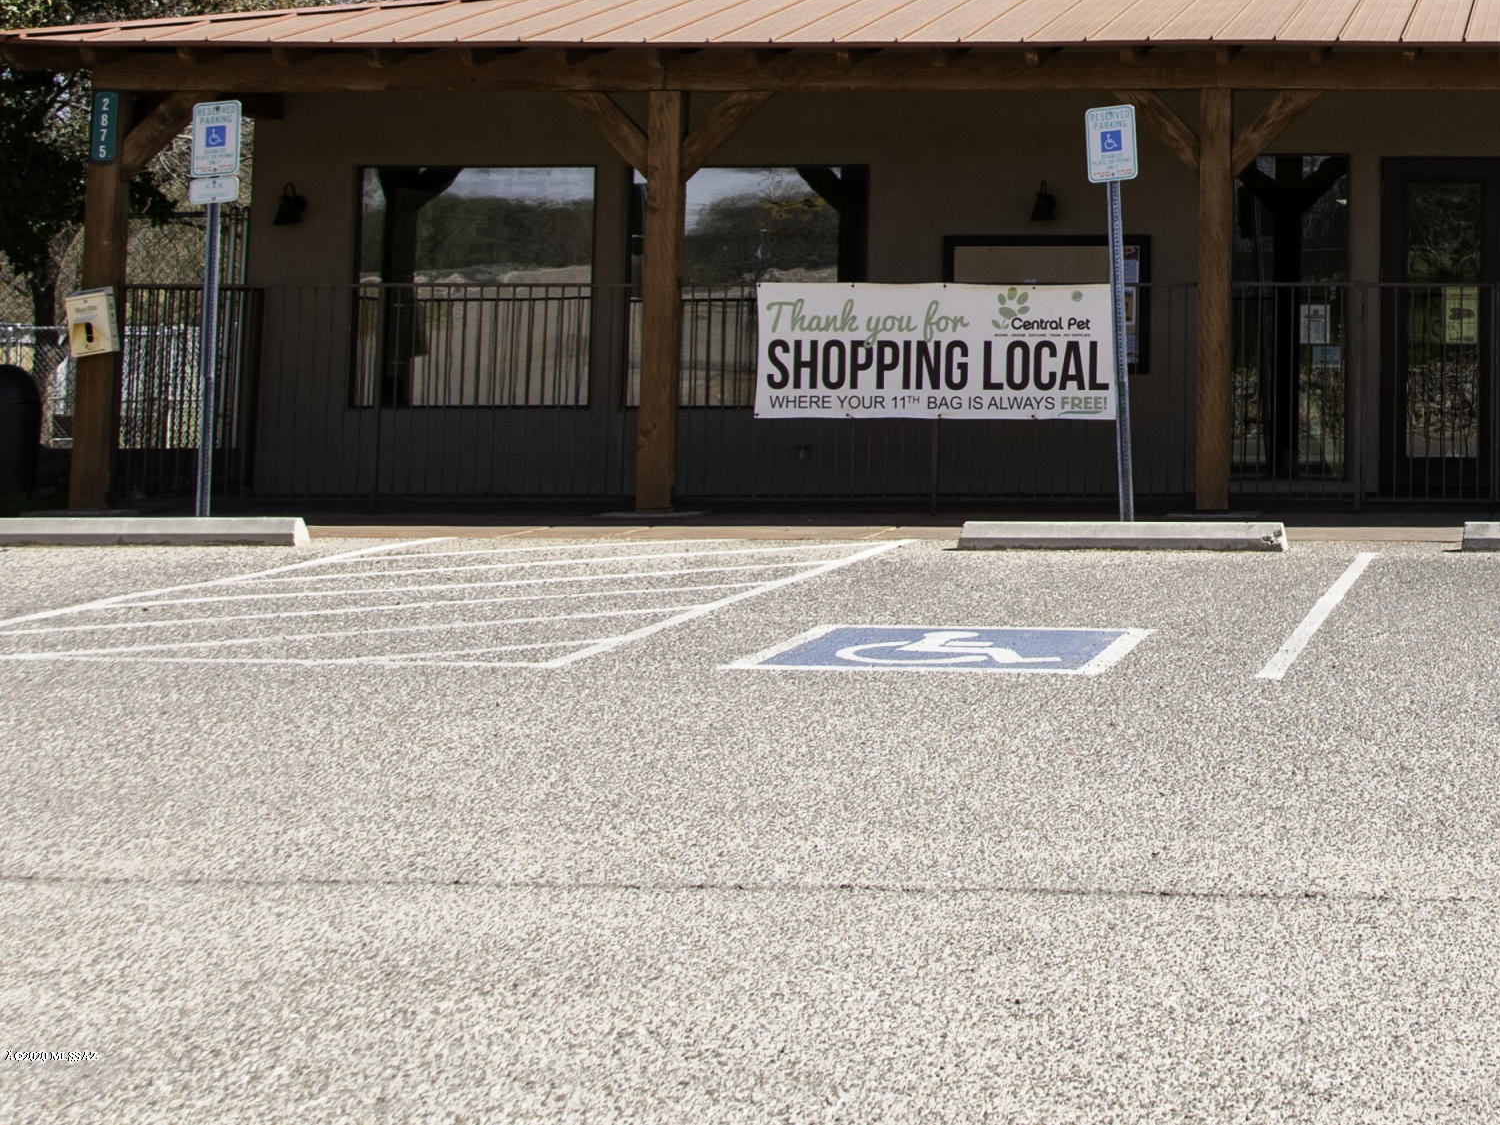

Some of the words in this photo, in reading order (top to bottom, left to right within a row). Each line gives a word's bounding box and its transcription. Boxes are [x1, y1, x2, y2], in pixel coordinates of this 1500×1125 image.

[98, 97, 110, 158] 2875
[199, 115, 233, 125] PARKING
[1094, 119, 1128, 130] PARKING
[766, 298, 859, 333] Thank
[863, 314, 918, 349] you
[922, 299, 970, 343] for
[1010, 316, 1064, 331] Central
[1067, 317, 1091, 331] Pet
[766, 339, 969, 391] SHOPPING
[982, 339, 1110, 391] LOCAL
[769, 395, 832, 409] WHERE
[837, 395, 885, 409] YOUR
[927, 396, 962, 410] BAG
[968, 396, 983, 410] IS
[987, 396, 1056, 410] ALWAYS
[1060, 396, 1108, 410] FREE!
